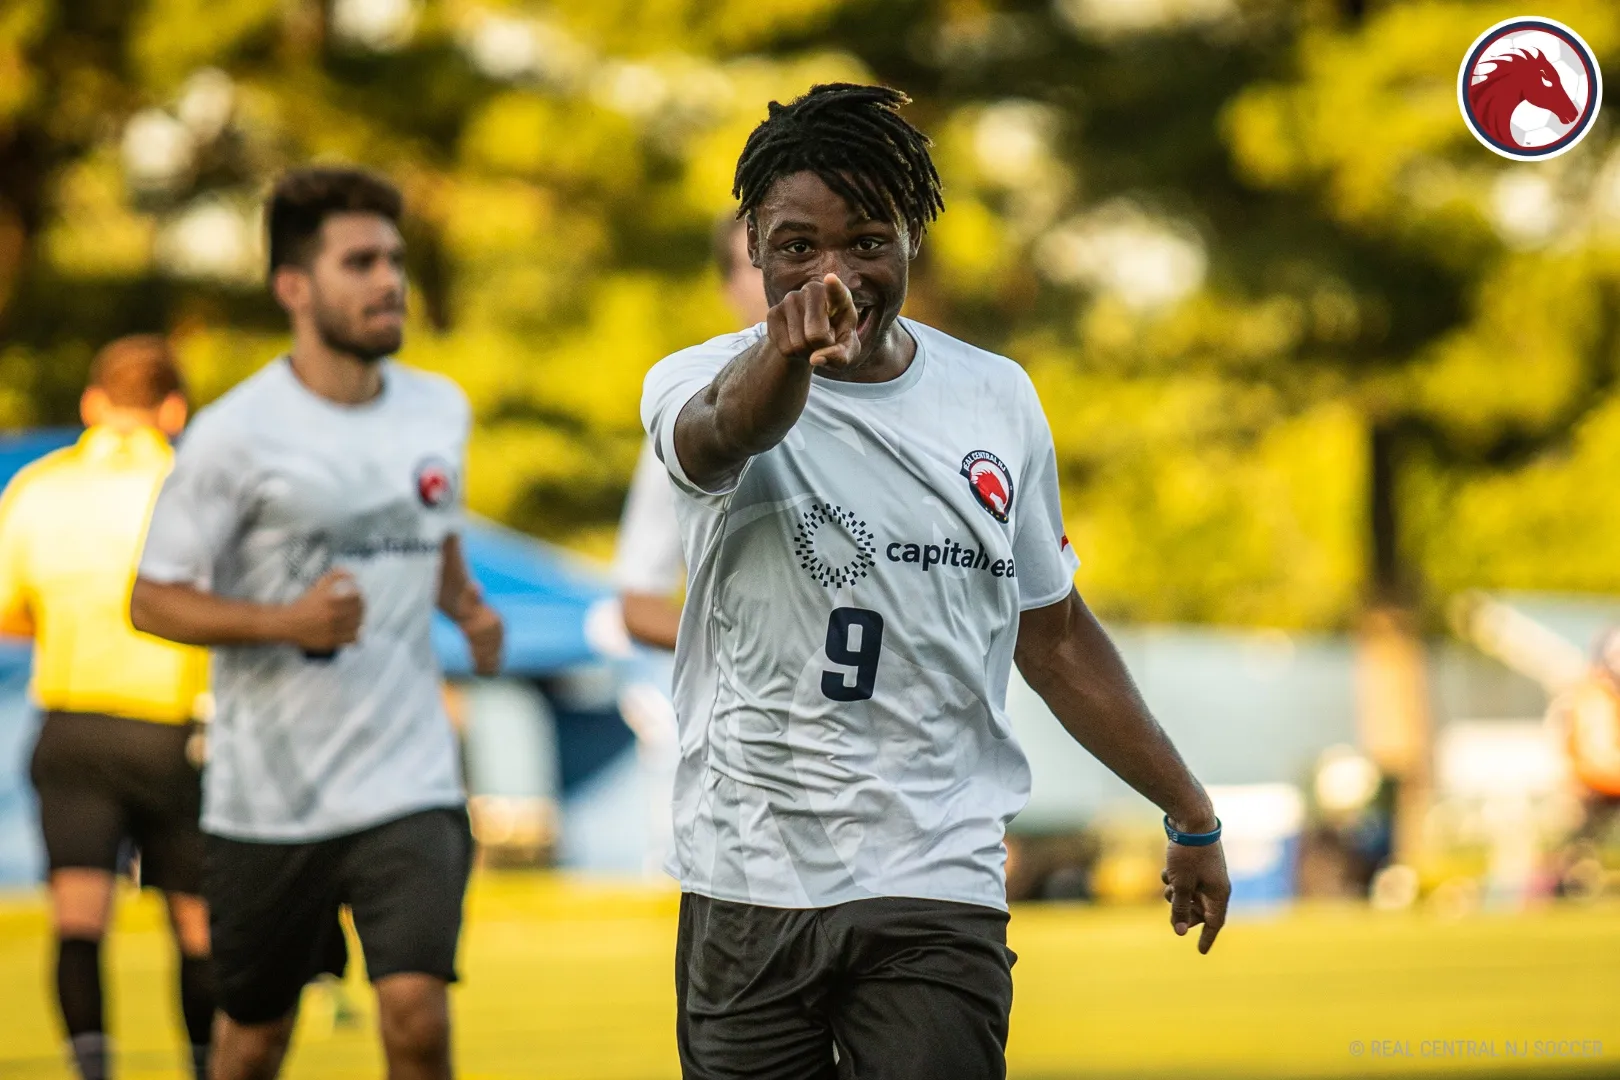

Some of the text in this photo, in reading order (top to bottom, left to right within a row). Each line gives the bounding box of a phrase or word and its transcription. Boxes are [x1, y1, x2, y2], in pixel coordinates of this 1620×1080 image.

[971, 451, 998, 464] CENTRAL
[997, 461, 1006, 472] NJ
[821, 607, 884, 702] 9
